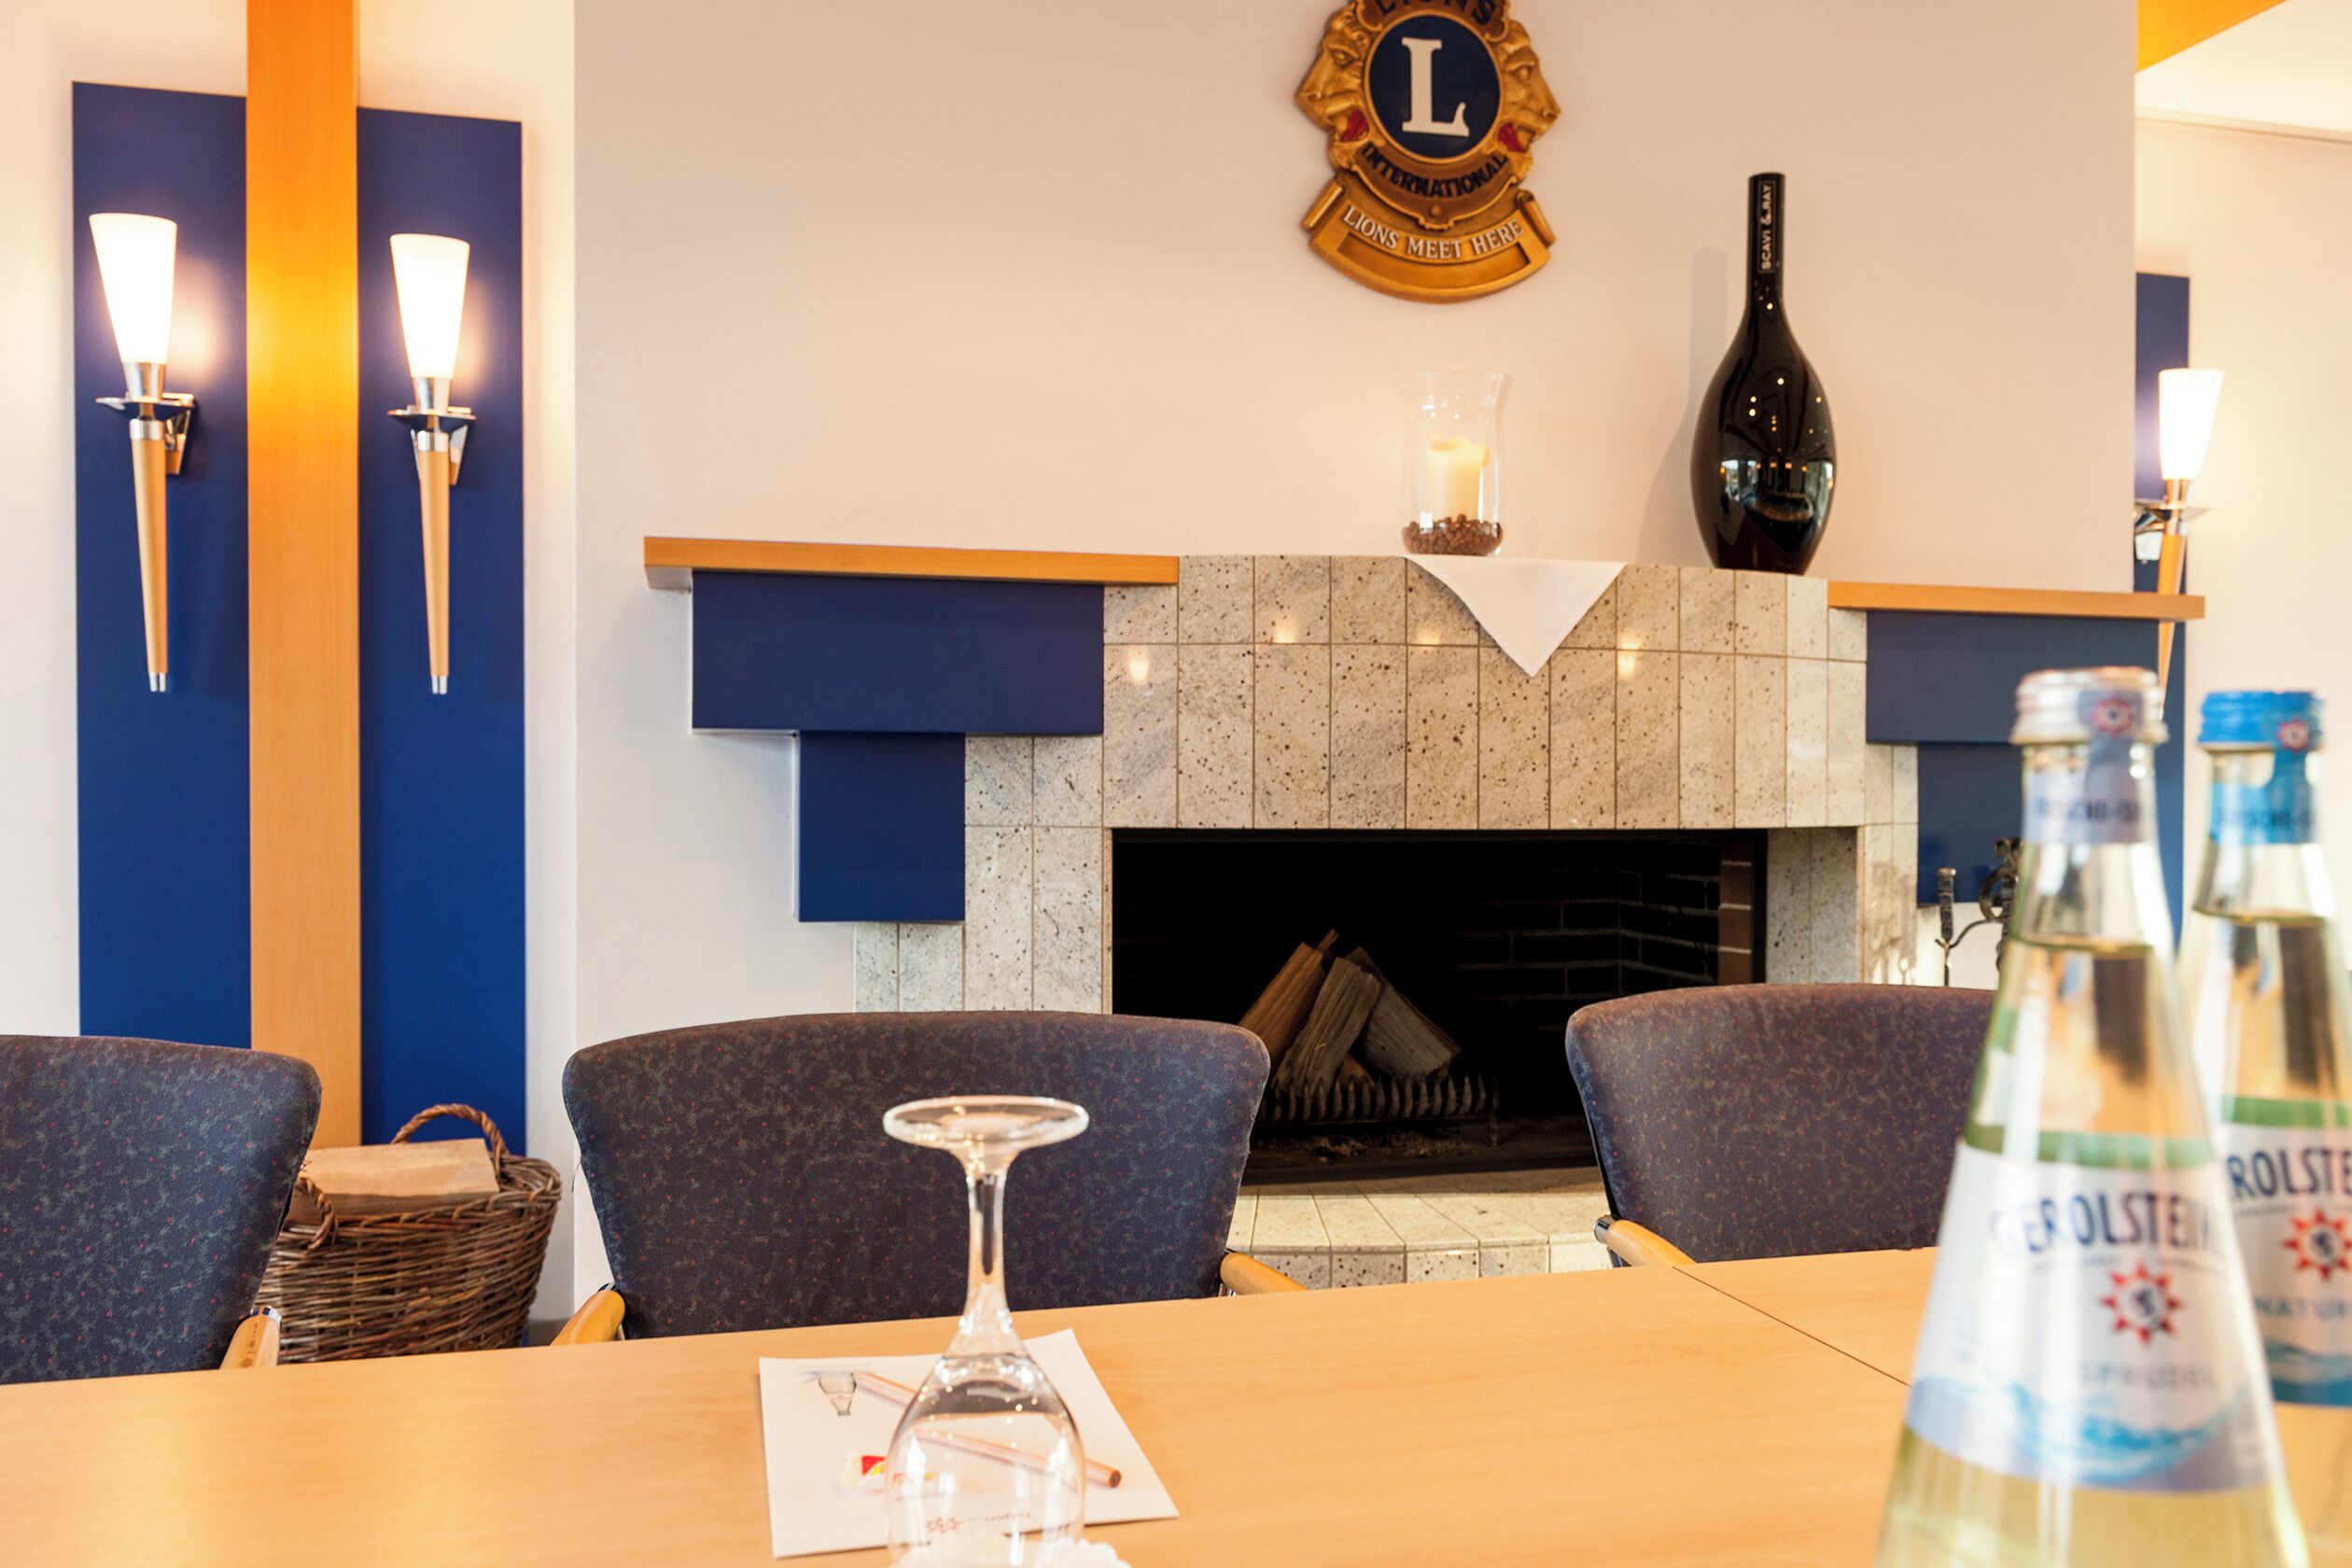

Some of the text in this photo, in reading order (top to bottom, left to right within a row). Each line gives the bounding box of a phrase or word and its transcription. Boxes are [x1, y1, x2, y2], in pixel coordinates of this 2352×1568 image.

[1401, 36, 1470, 137] L
[1361, 143, 1508, 199] INTERNATIONAL
[1342, 206, 1525, 259] LIONS MEET HERE
[1761, 229, 1772, 270] SCAVI
